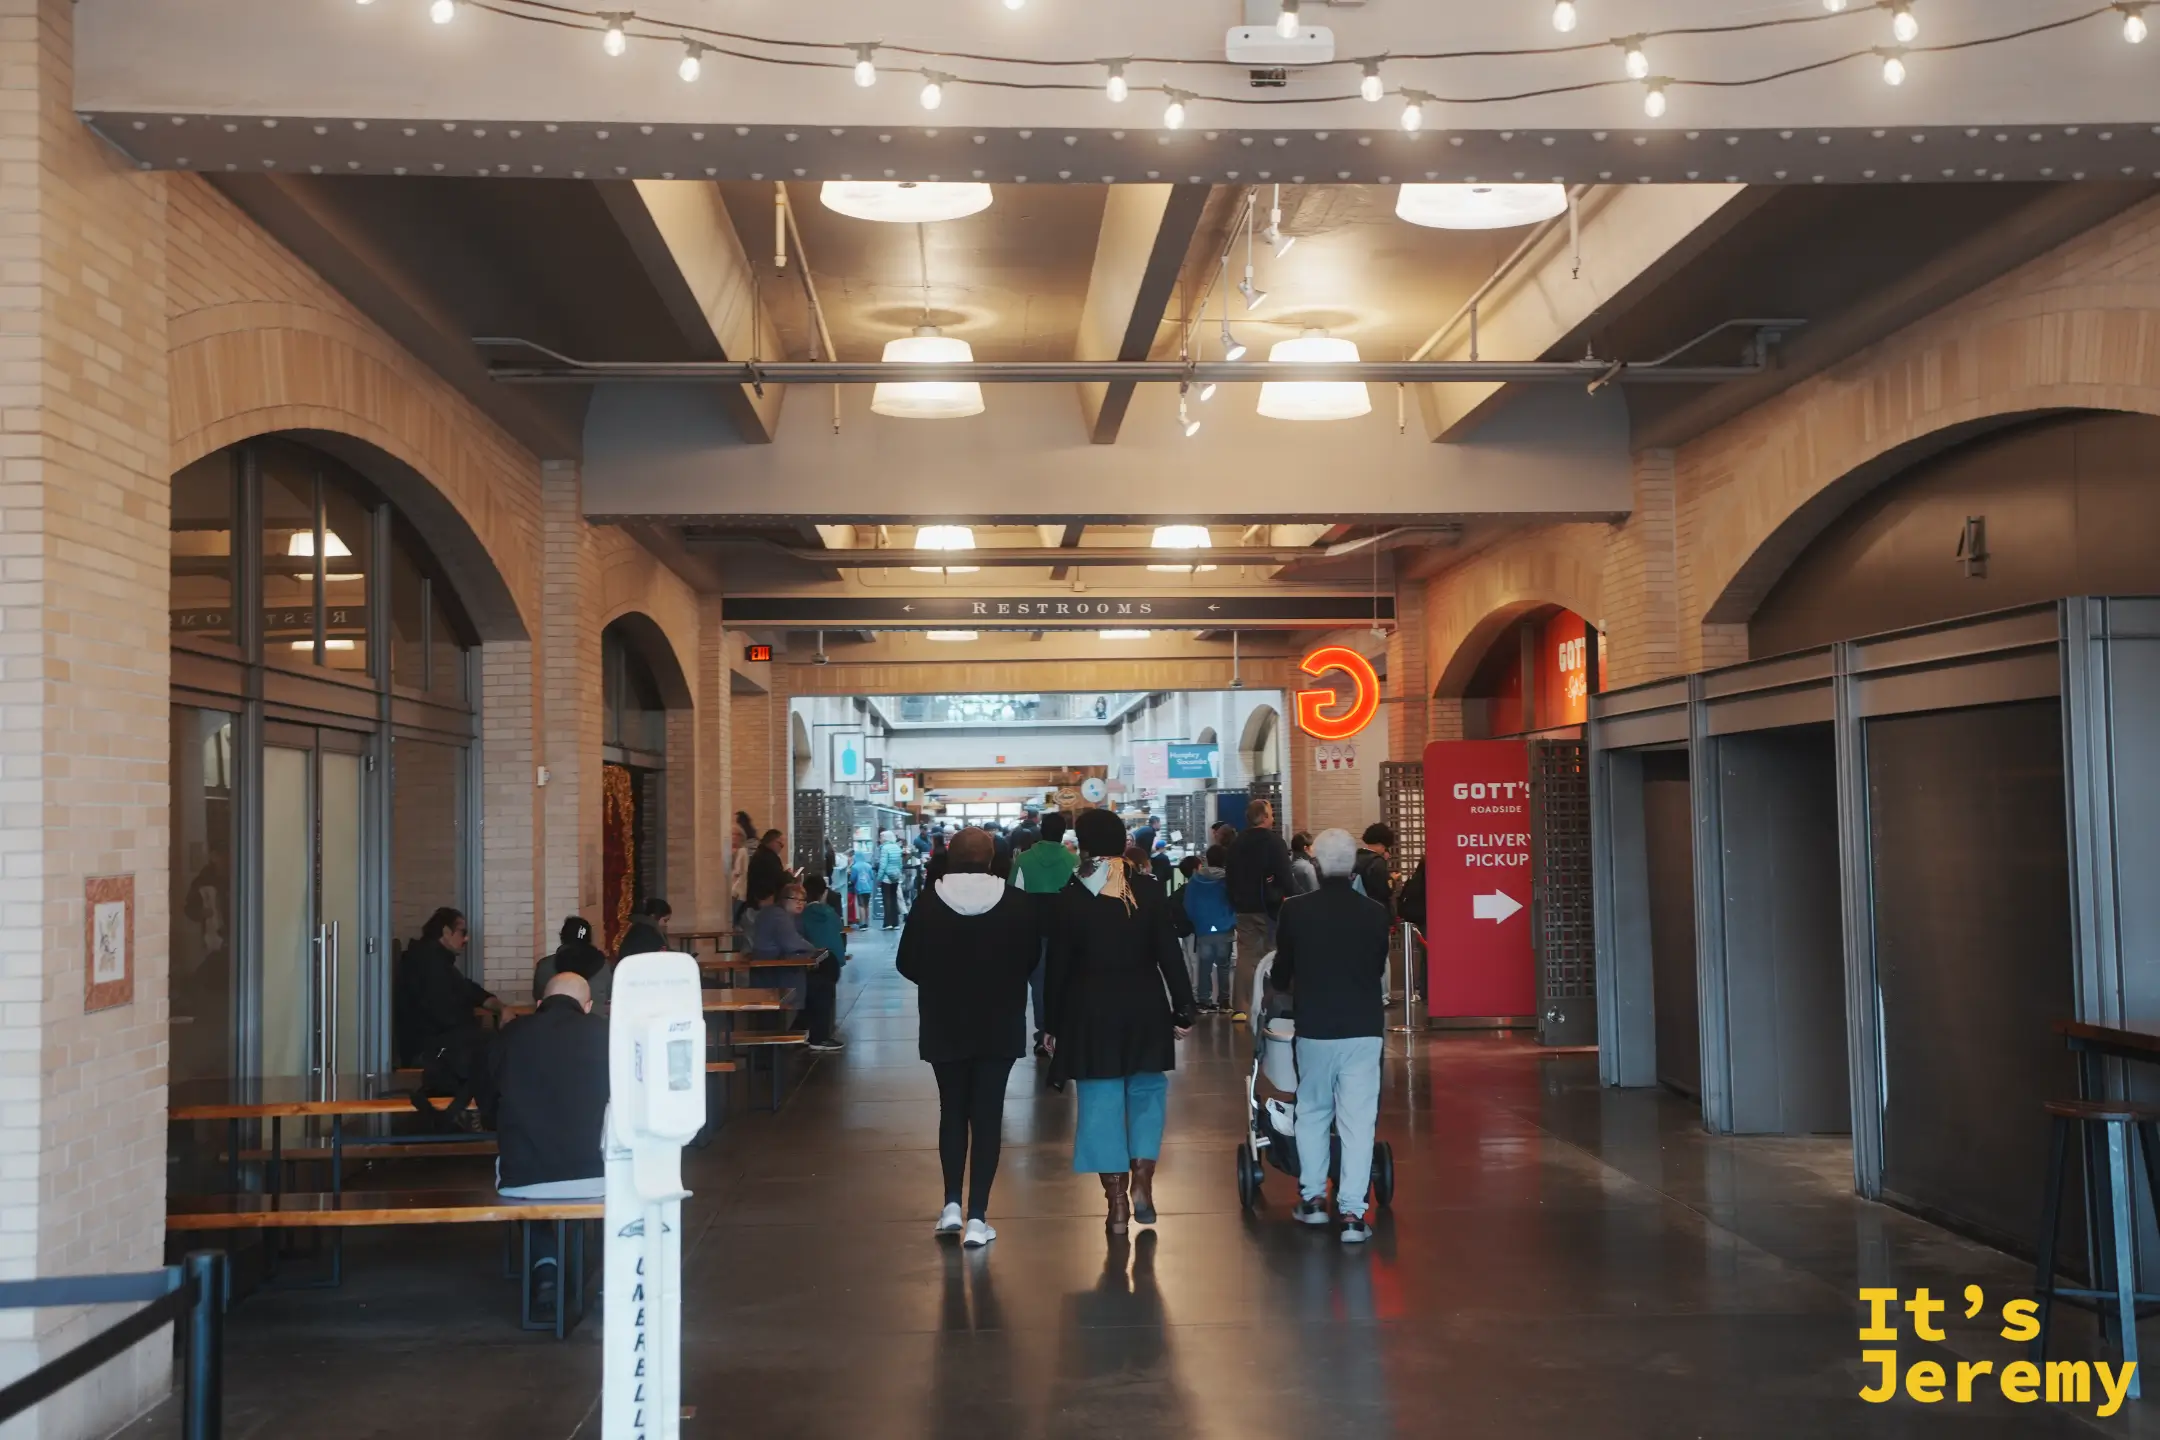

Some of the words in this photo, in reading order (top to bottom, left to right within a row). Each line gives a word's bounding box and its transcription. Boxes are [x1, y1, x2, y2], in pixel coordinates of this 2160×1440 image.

[972, 602, 1152, 614] RESTROOMS
[752, 646, 770, 660] EXIT
[1470, 805, 1522, 814] ROADSIDE
[1457, 833, 1531, 847] DELIVER
[1465, 853, 1529, 867] PICKUP
